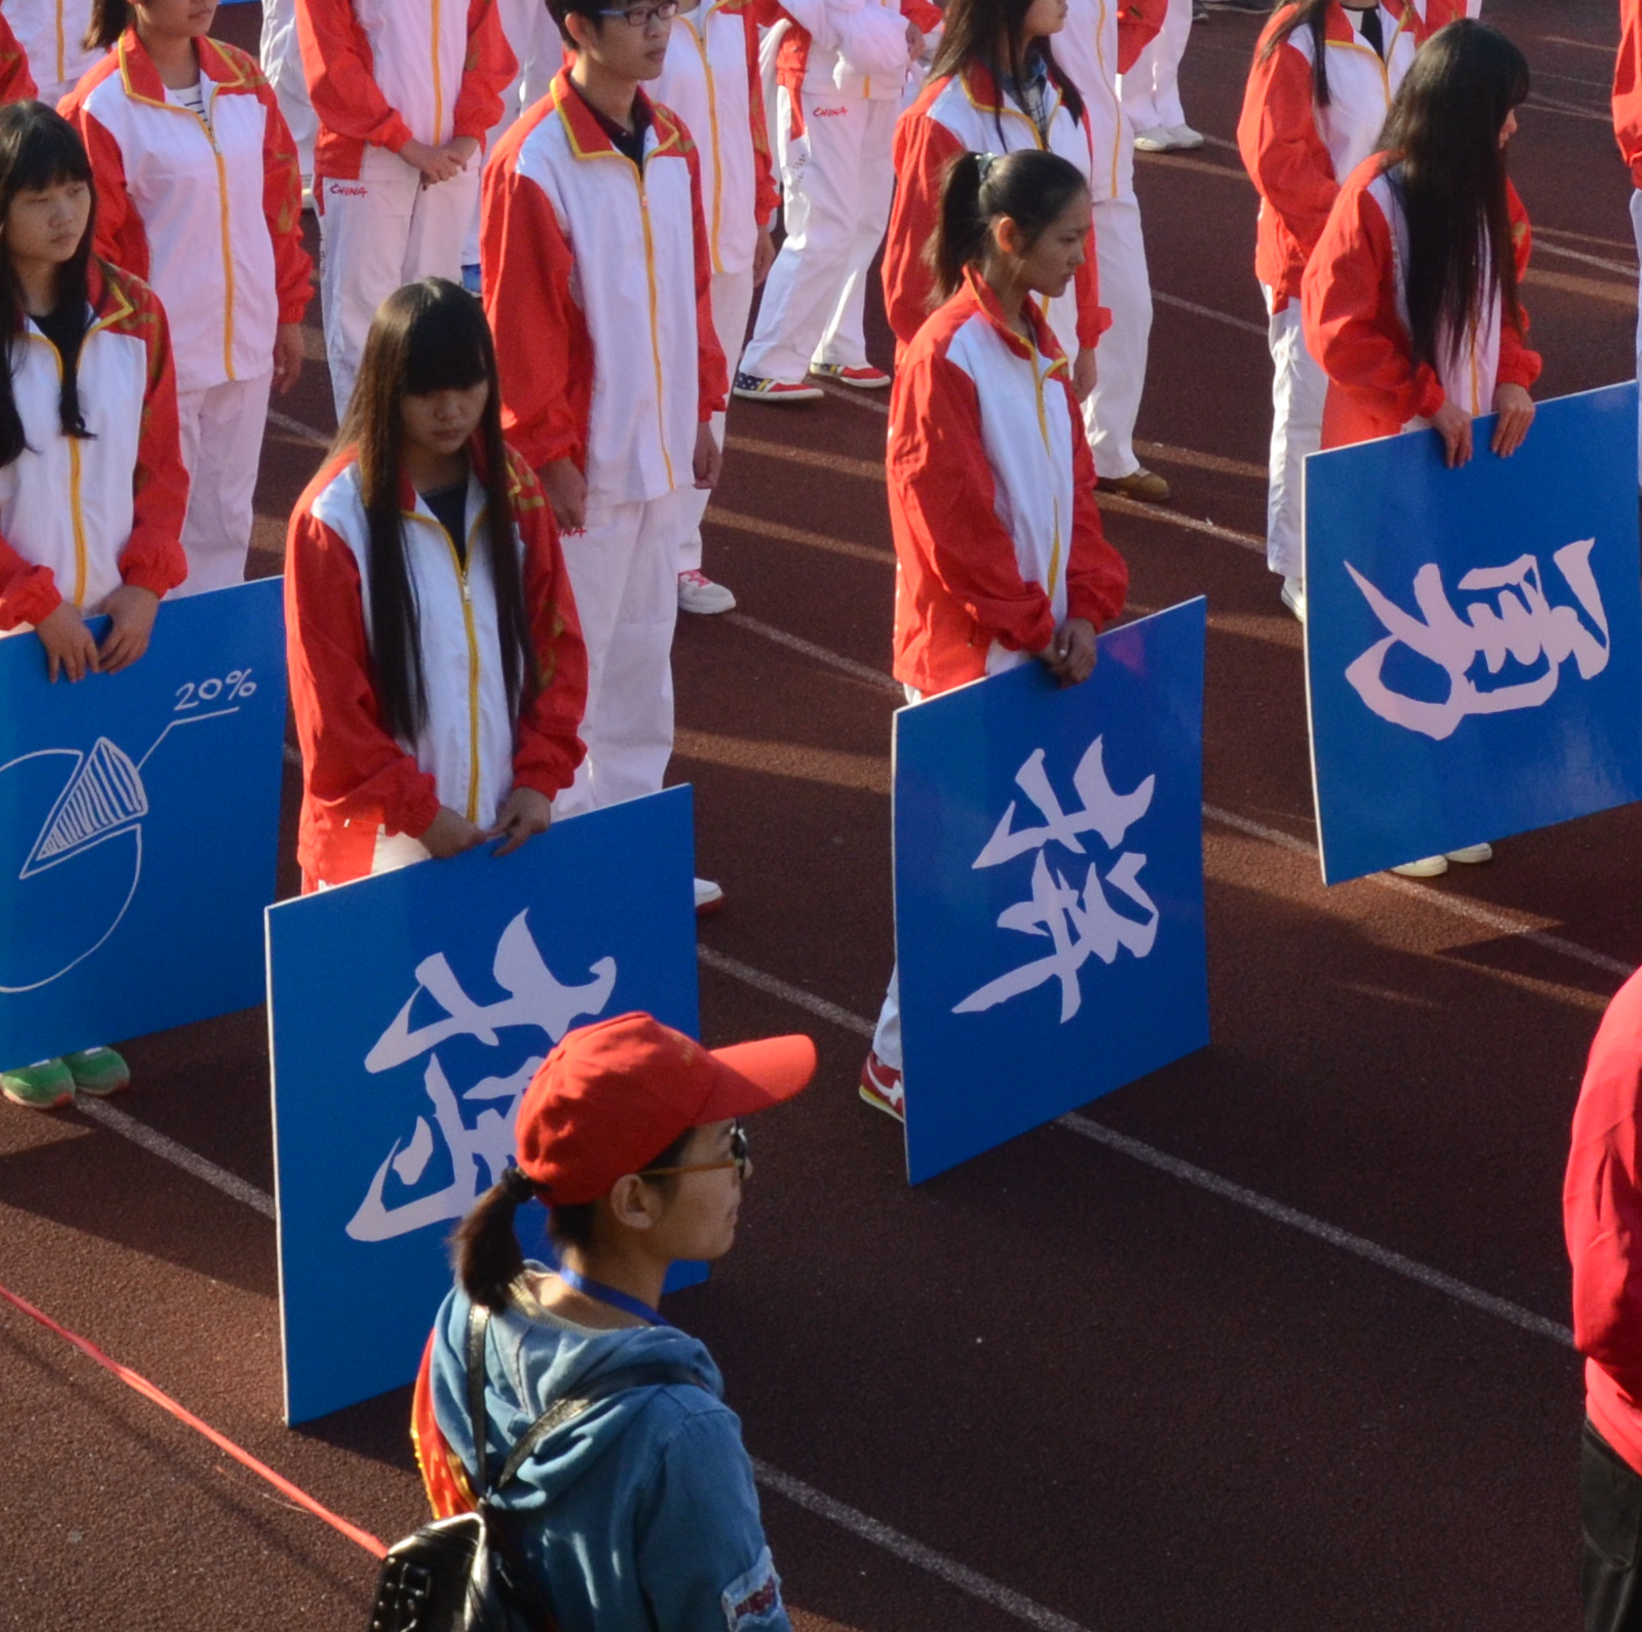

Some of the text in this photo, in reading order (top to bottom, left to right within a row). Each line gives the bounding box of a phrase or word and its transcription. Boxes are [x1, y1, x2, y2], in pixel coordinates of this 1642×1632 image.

[174, 668, 257, 711] 20%
[1344, 536, 1611, 740] 勇
[951, 734, 1158, 1023] 拼
